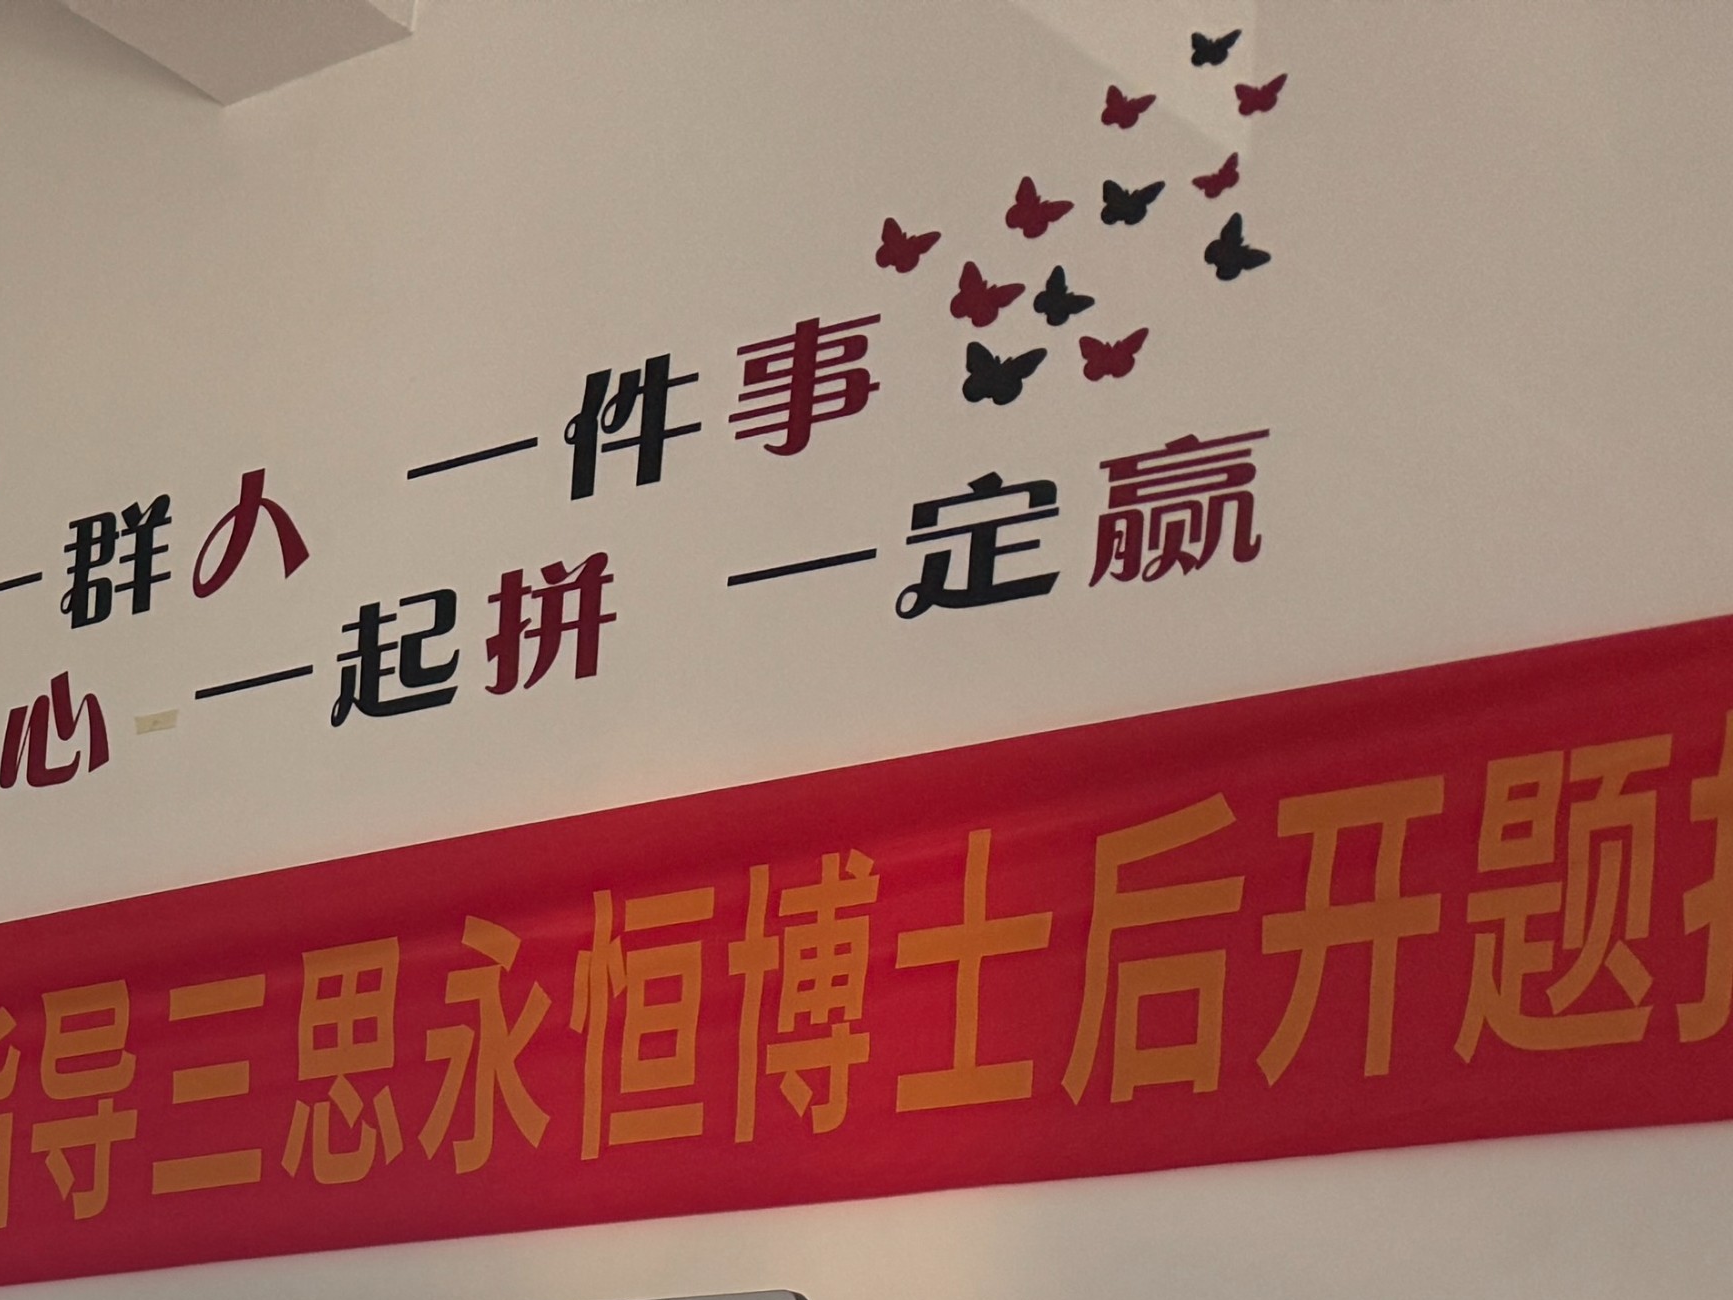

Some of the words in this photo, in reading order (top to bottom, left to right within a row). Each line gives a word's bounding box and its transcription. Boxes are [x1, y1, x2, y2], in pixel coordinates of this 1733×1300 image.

[406, 313, 881, 501] 一件事
[194, 551, 619, 728] 一起拼
[726, 427, 1271, 621] 一定赢
